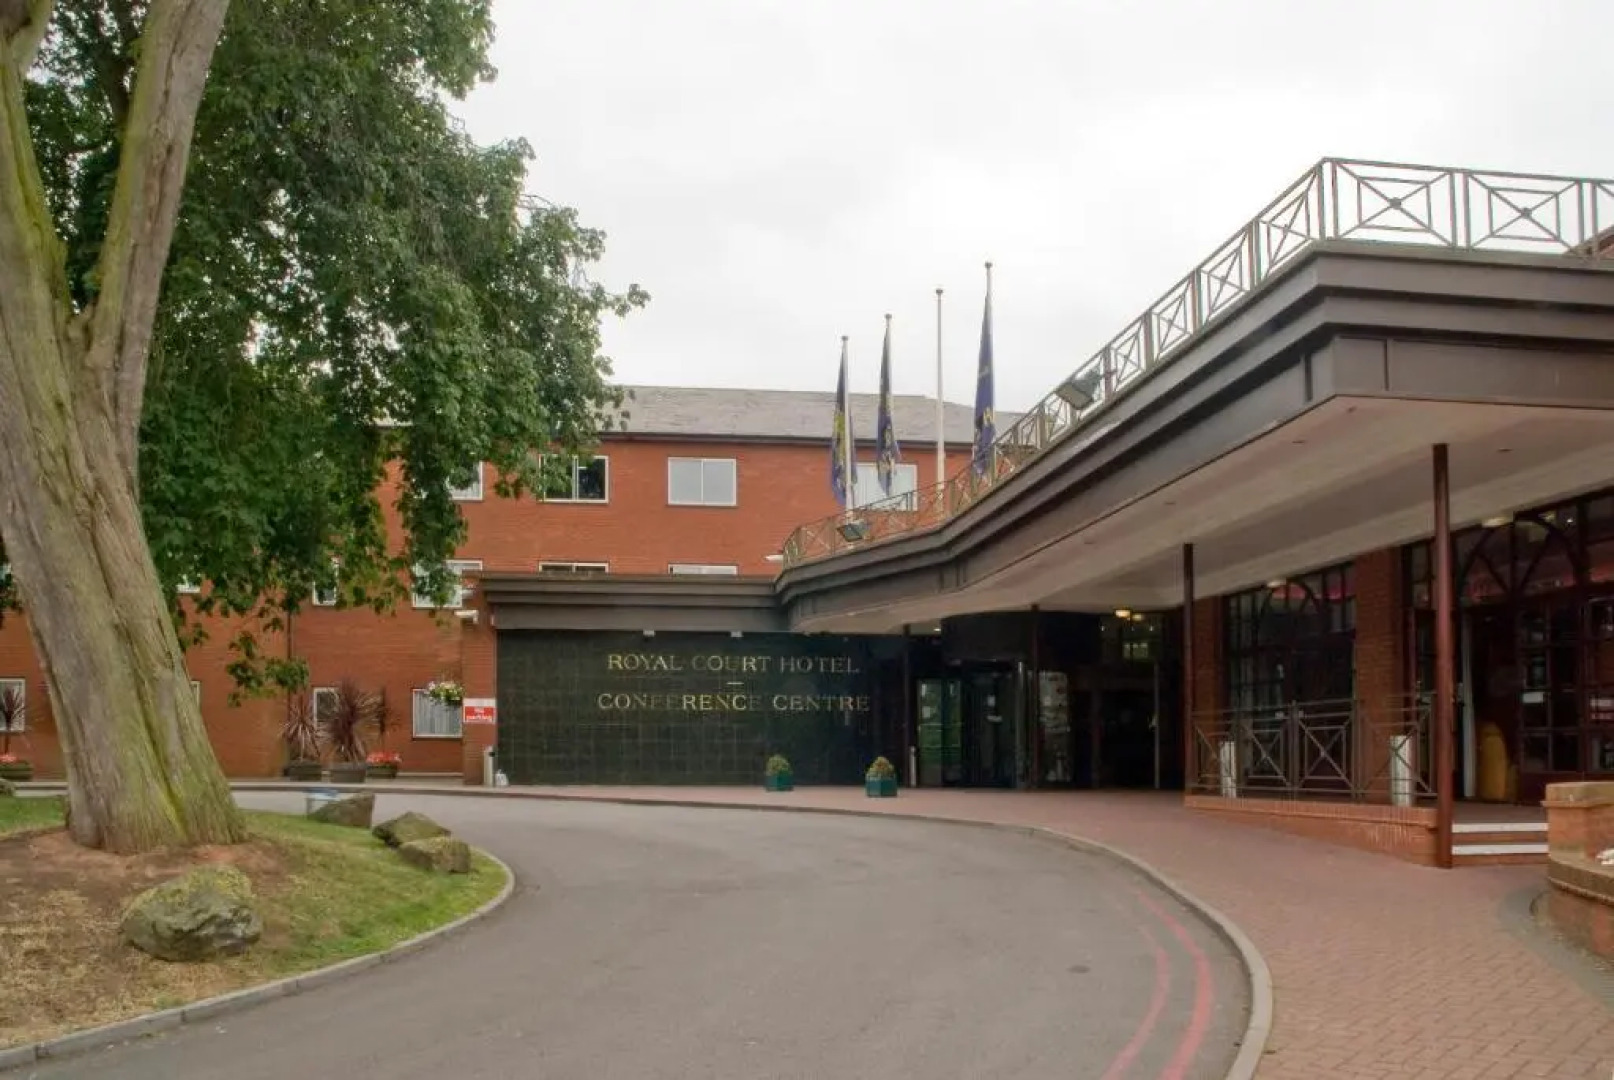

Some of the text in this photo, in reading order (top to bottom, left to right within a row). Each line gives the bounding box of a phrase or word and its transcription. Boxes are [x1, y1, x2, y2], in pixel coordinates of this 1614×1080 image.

[607, 654, 859, 673] ROYAL COURT HOTEL
[597, 693, 870, 712] CONFERENCE CENTRE
